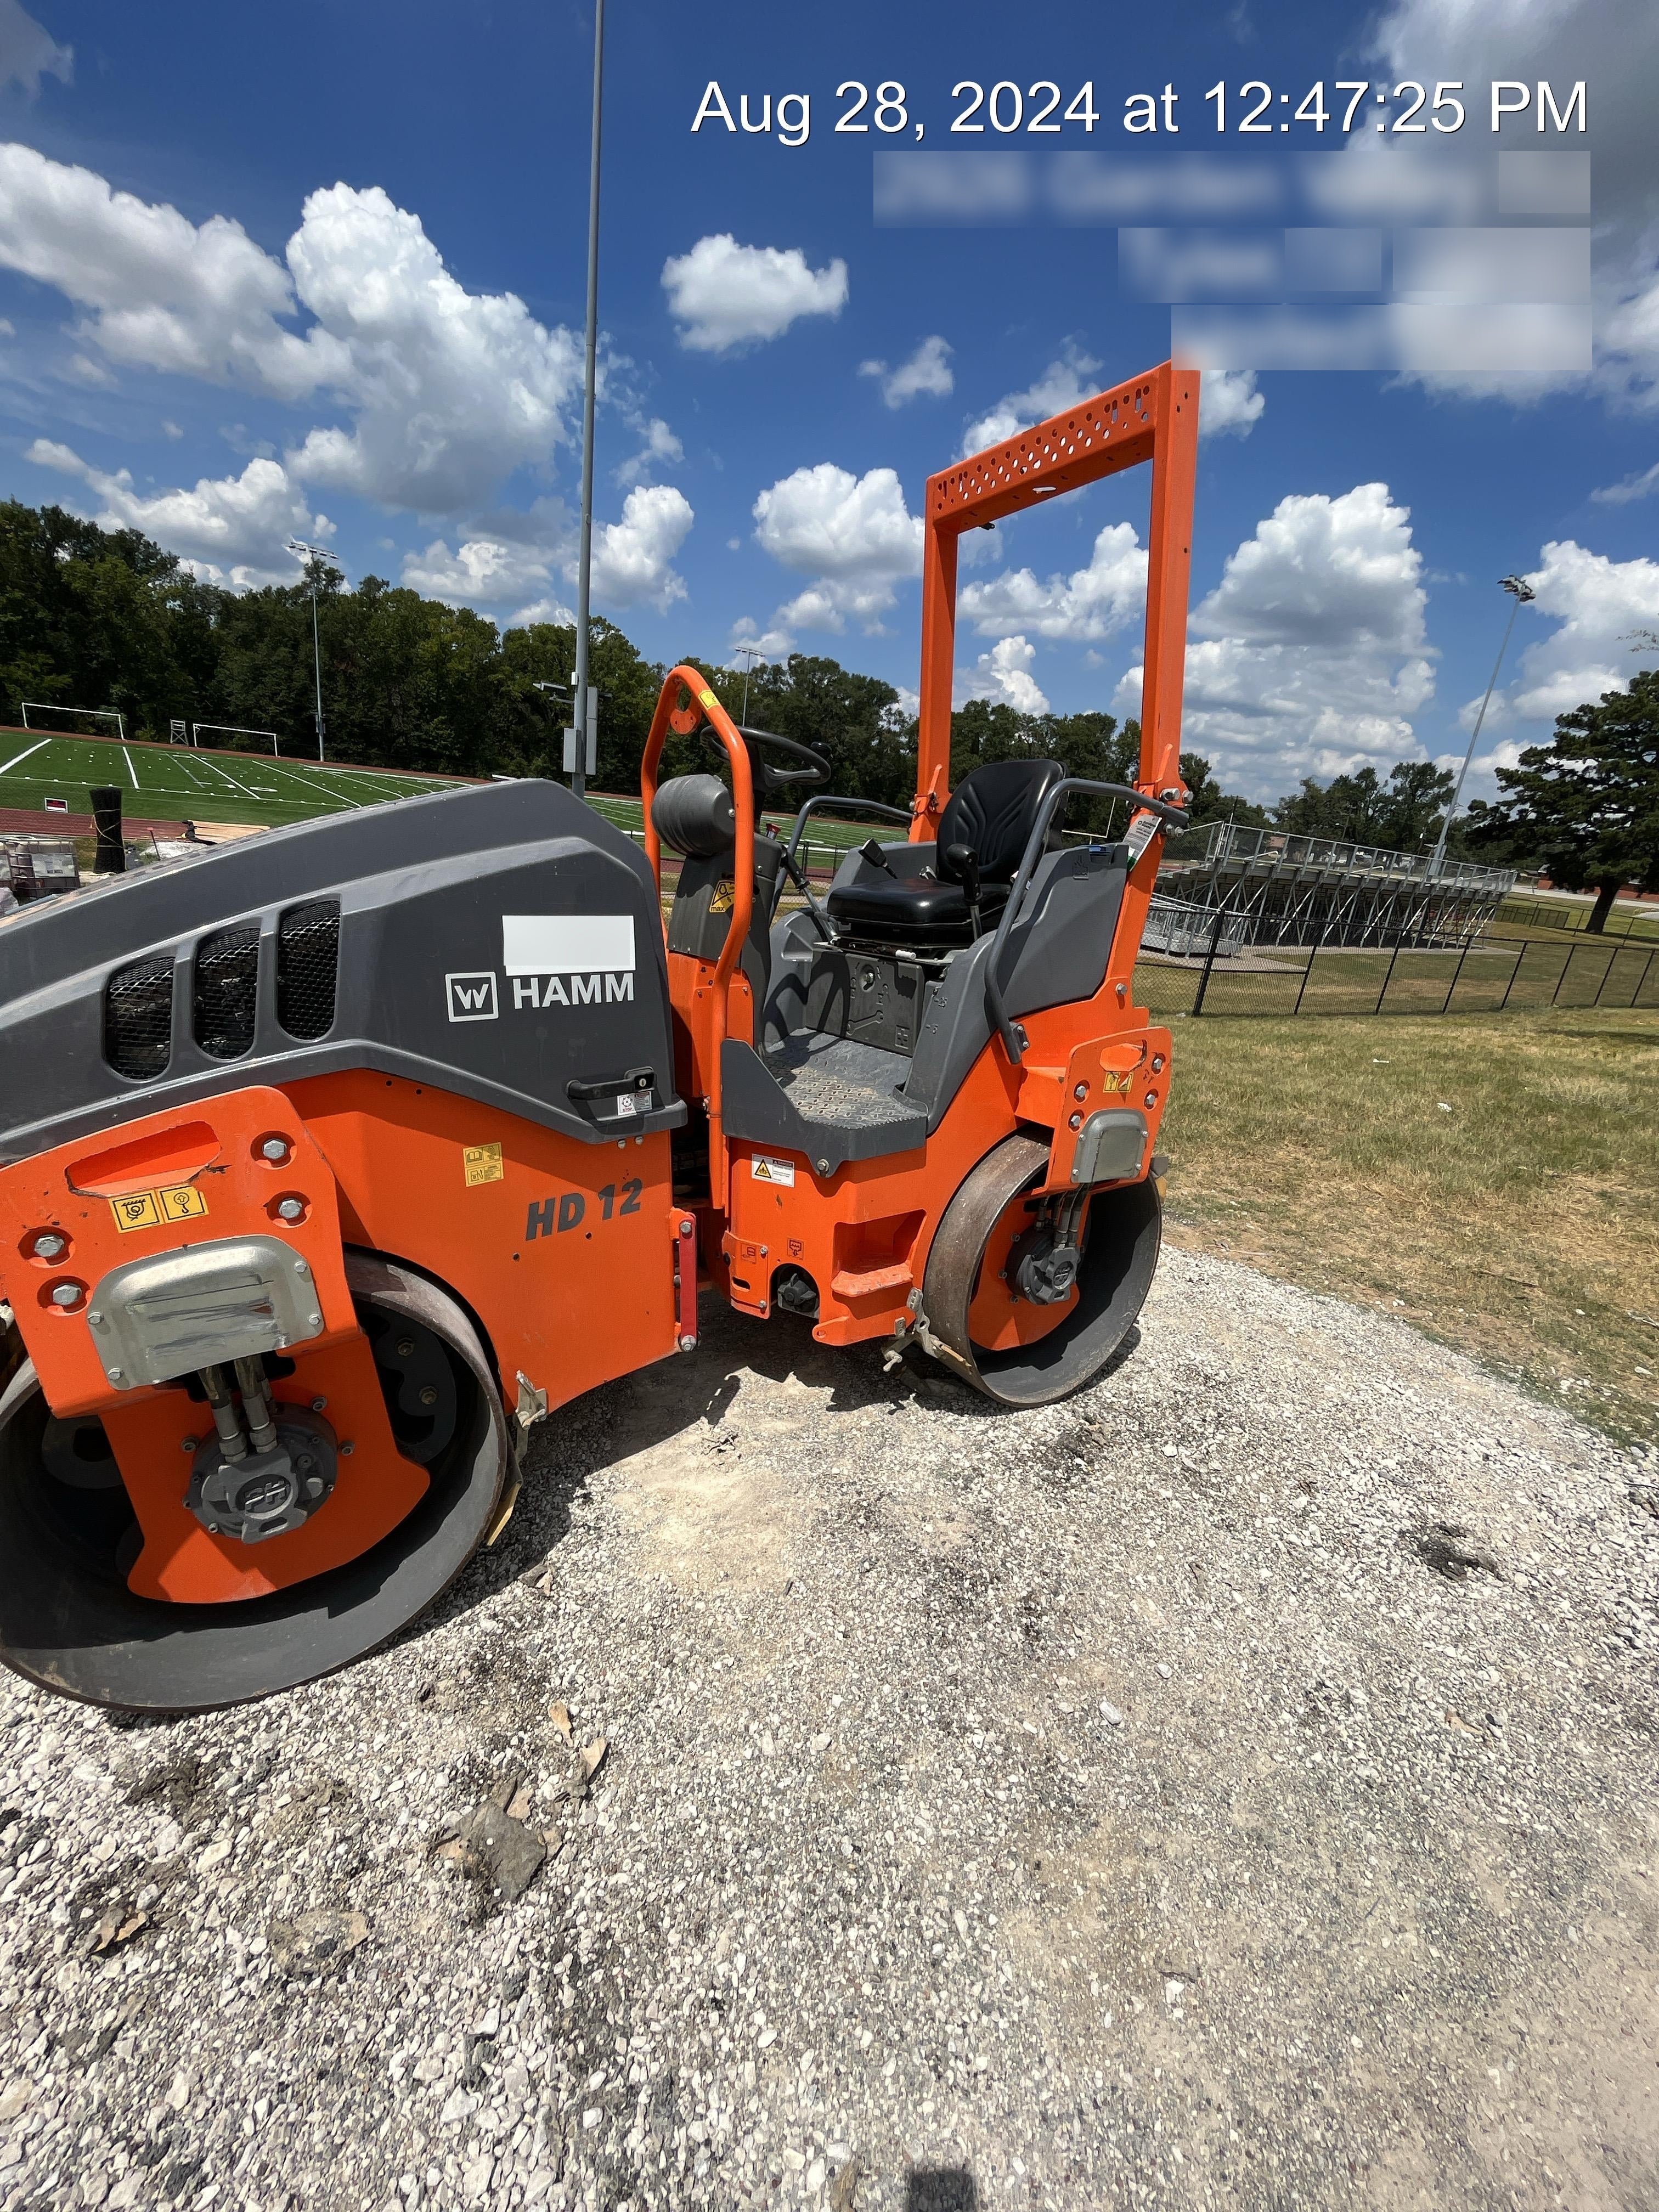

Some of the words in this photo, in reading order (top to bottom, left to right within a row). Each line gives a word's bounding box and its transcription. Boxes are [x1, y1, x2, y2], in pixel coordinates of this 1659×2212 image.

[512, 973, 634, 1009] HAMM
[525, 1193, 585, 1242] HD
[597, 1177, 643, 1221] 12
